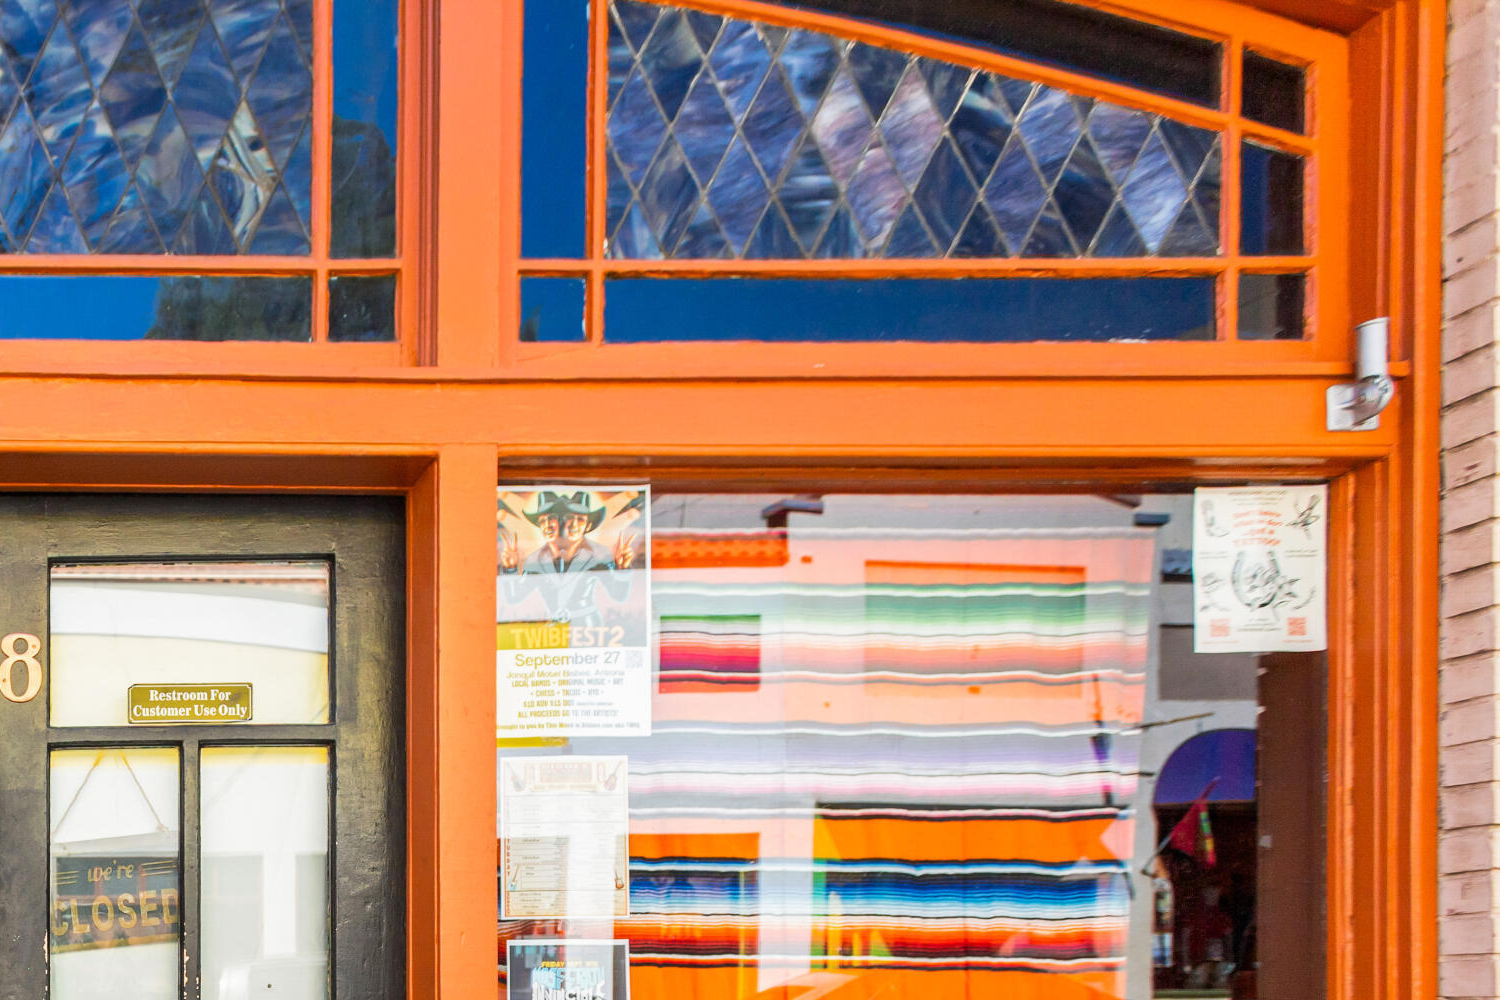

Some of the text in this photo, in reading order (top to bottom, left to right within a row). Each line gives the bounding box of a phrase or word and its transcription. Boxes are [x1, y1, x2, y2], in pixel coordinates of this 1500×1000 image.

[515, 651, 621, 670] September 27
[512, 680, 529, 688] LOCAL
[149, 688, 231, 701] Restroom For
[133, 704, 248, 717] Customer Use Only
[87, 859, 134, 882] we're
[51, 888, 179, 937] CLOSED
